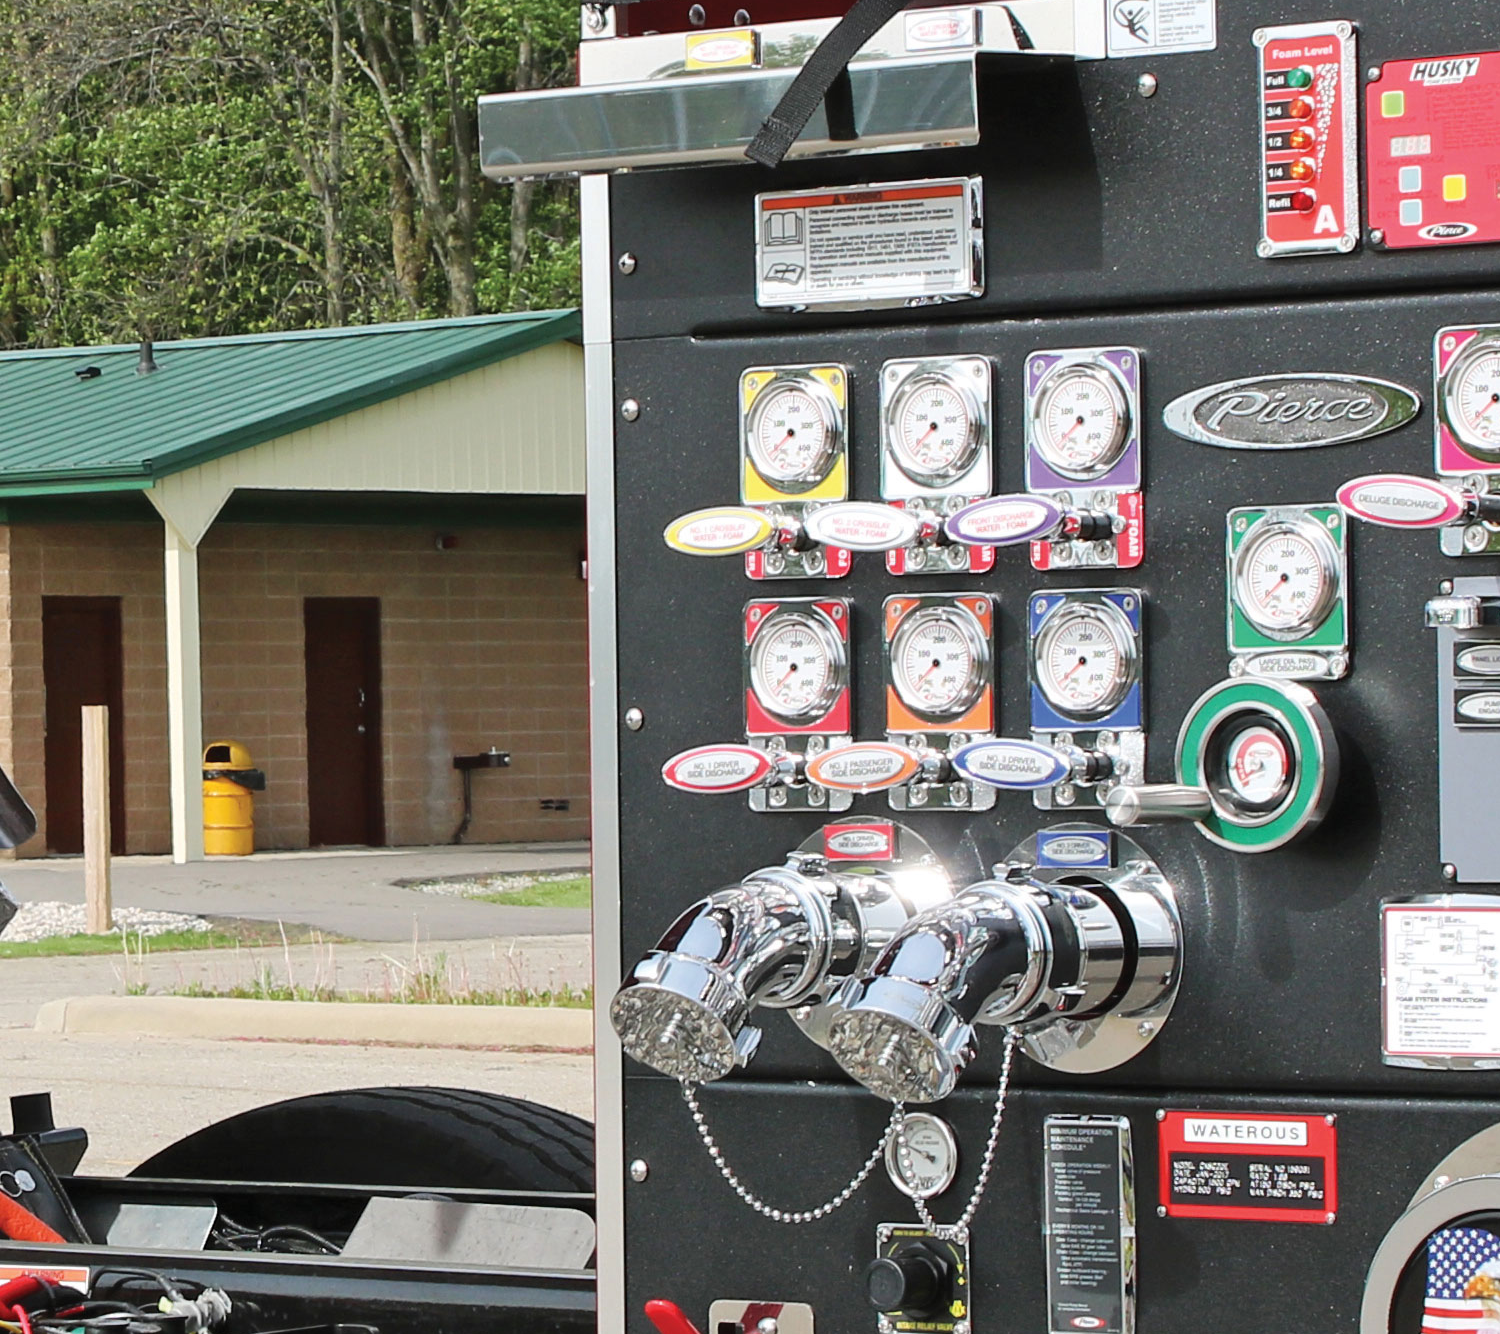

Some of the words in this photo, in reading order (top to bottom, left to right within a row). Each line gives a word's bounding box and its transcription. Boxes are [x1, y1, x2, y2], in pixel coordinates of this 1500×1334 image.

[1273, 48, 1301, 59] Foam
[1304, 44, 1333, 57] Level
[1413, 59, 1478, 80] HUSKY
[1266, 75, 1285, 86] Full
[1266, 107, 1282, 116] 3/4
[1268, 137, 1282, 147] 1/2
[1268, 167, 1284, 178] 1/4
[1313, 205, 1339, 234] A
[1429, 224, 1464, 237] Pierce
[1206, 392, 1376, 431] Pierce
[1358, 493, 1394, 506] DELUGE
[1395, 495, 1440, 510] DISCHARGE
[967, 517, 992, 527] FRONT
[993, 510, 1036, 522] DISCHARGE
[975, 524, 1001, 534] WATER
[1006, 521, 1028, 530] FOAM
[1129, 518, 1139, 557] FOAM
[1258, 657, 1281, 666] LARGE
[1282, 657, 1296, 665] DIA.
[1472, 655, 1490, 663] PANEL
[1260, 664, 1276, 672] SIDE
[1277, 663, 1317, 671] DISCHARGE
[693, 762, 706, 770] NO.
[712, 760, 739, 768] DRIVER
[829, 762, 842, 771] NO.
[849, 758, 893, 768] PASSENGER
[987, 755, 1001, 763] NO.
[1008, 756, 1035, 764] DRIVER
[688, 770, 704, 778] SIDE
[705, 768, 746, 777] DISCHARGE
[831, 770, 846, 778] SIDE
[848, 767, 891, 776] DISCHARGE
[979, 761, 996, 770] SIDE
[998, 763, 1042, 774] DISCHARGE
[1192, 1124, 1299, 1140] WATEROUS
[1051, 1136, 1094, 1144] MAINTENANCE
